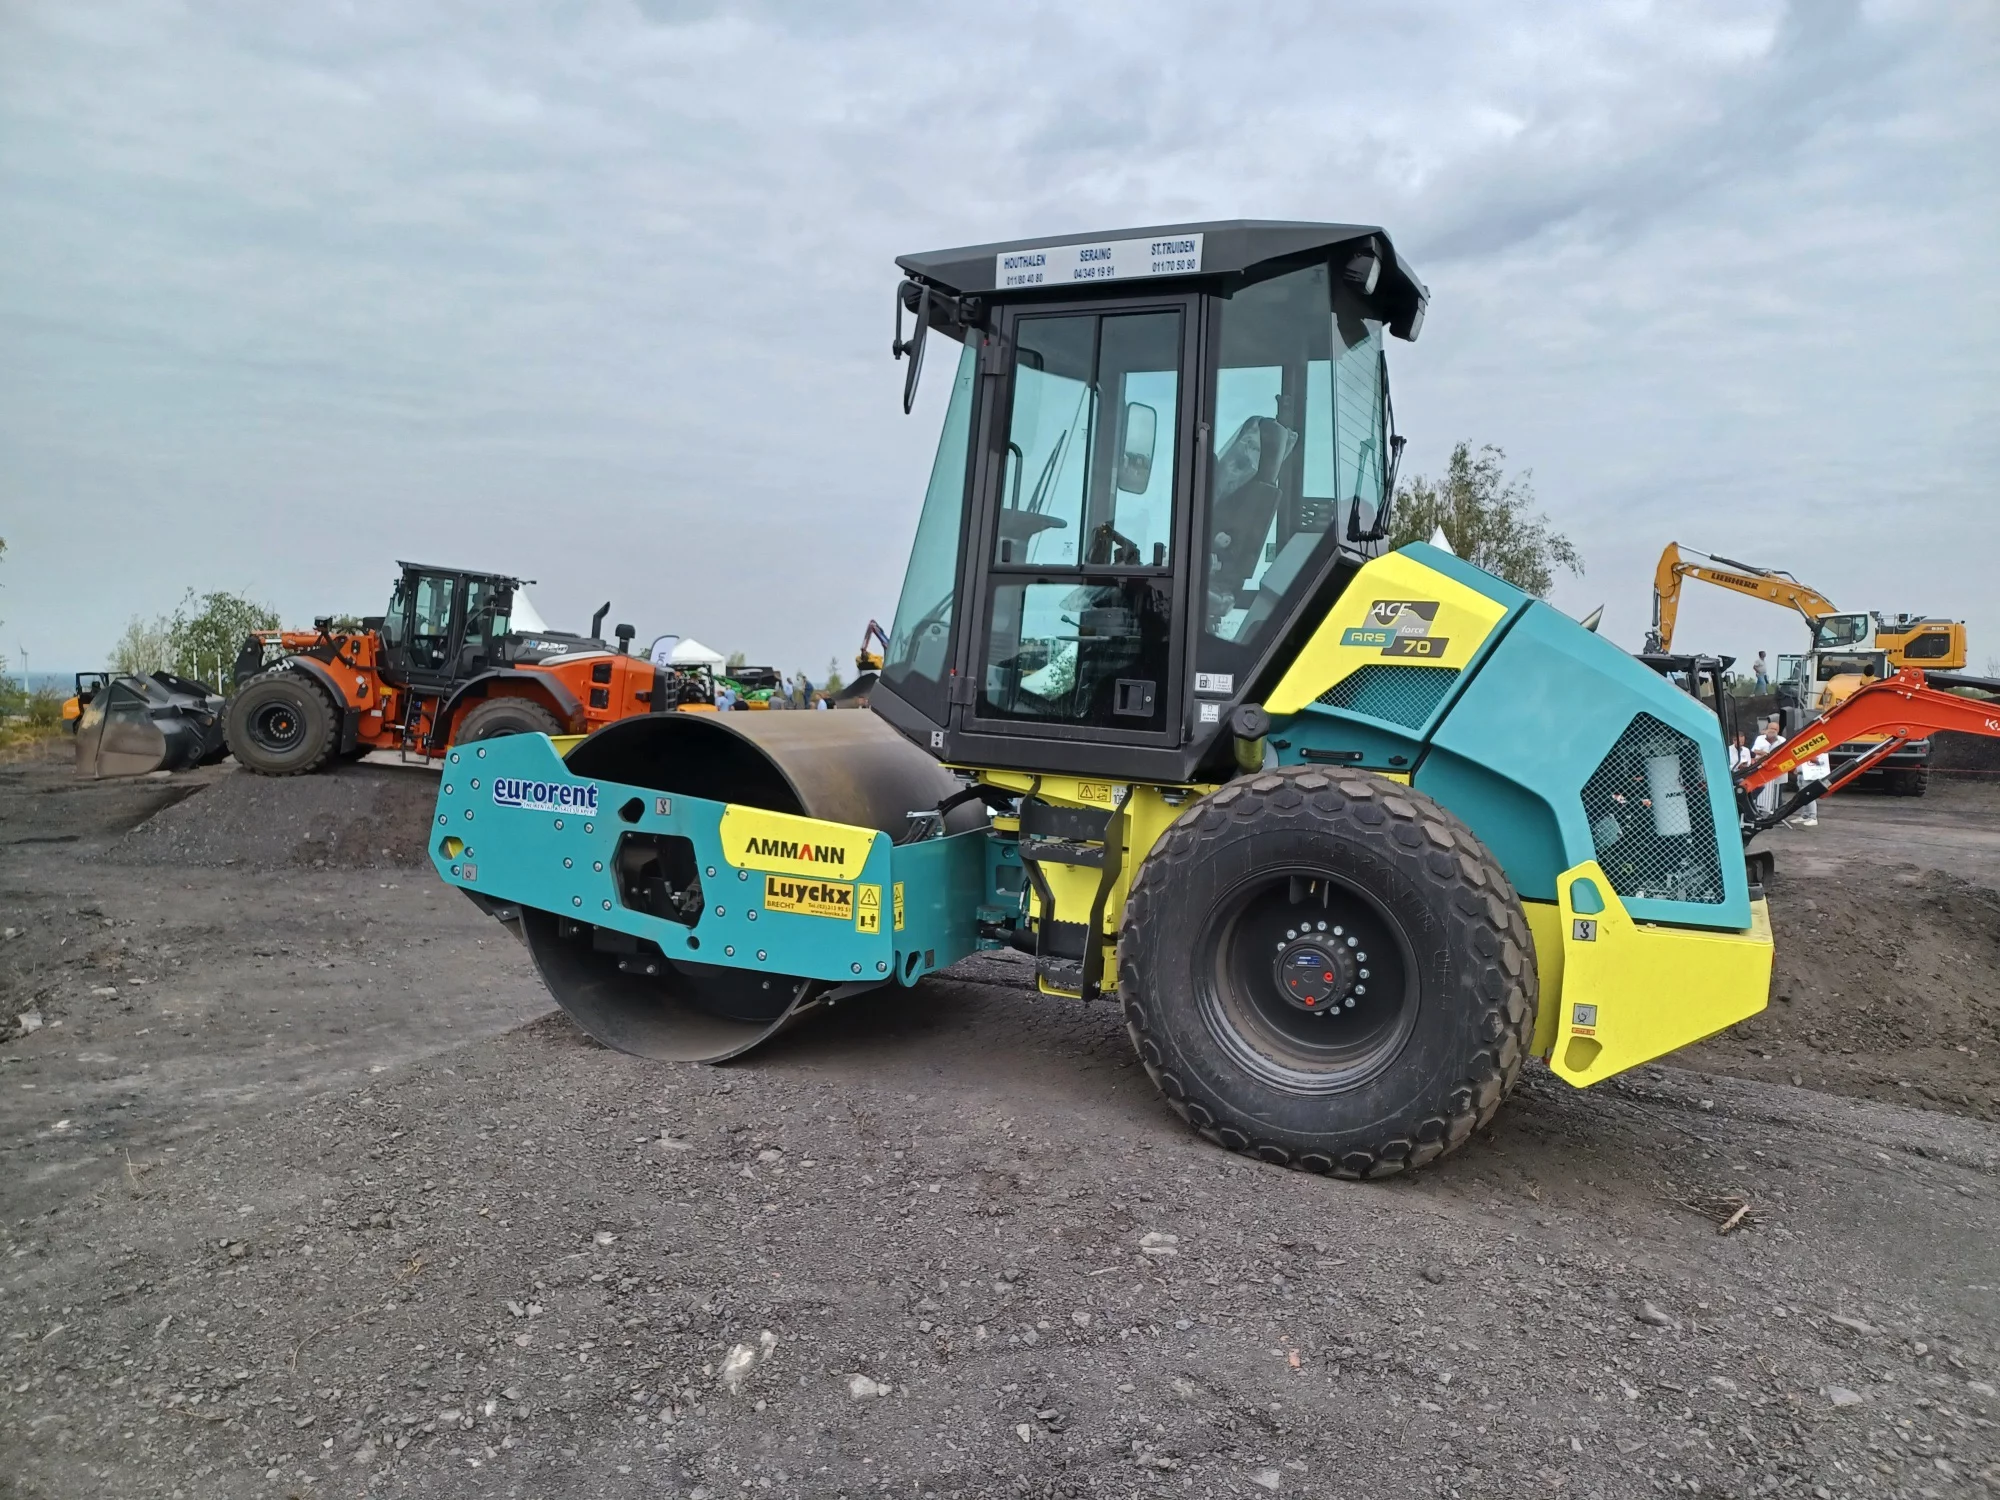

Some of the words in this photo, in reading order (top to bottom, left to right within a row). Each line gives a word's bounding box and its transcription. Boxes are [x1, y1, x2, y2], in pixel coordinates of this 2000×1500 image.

[1080, 248, 1111, 261] SERAING
[1151, 240, 1195, 255] ST.TRUIDEN
[1004, 254, 1046, 269] HOUTHALEN
[1152, 260, 1175, 272] 011/70
[1176, 259, 1186, 271] 50
[1186, 258, 1196, 270] 90
[1074, 267, 1096, 279] 04/349
[1097, 266, 1105, 277] 19
[1106, 265, 1115, 277] 91
[1711, 572, 1759, 590] LIEBHERR
[1371, 602, 1412, 617] ACE
[1401, 625, 1425, 634] force
[1351, 632, 1386, 643] ARS
[1403, 640, 1432, 654] 70
[1792, 735, 1826, 755] Luyckx
[494, 778, 598, 808] eurorent
[745, 837, 845, 865] AMMANN
[767, 877, 852, 905] Luyckx
[767, 900, 796, 910] BRECHT
